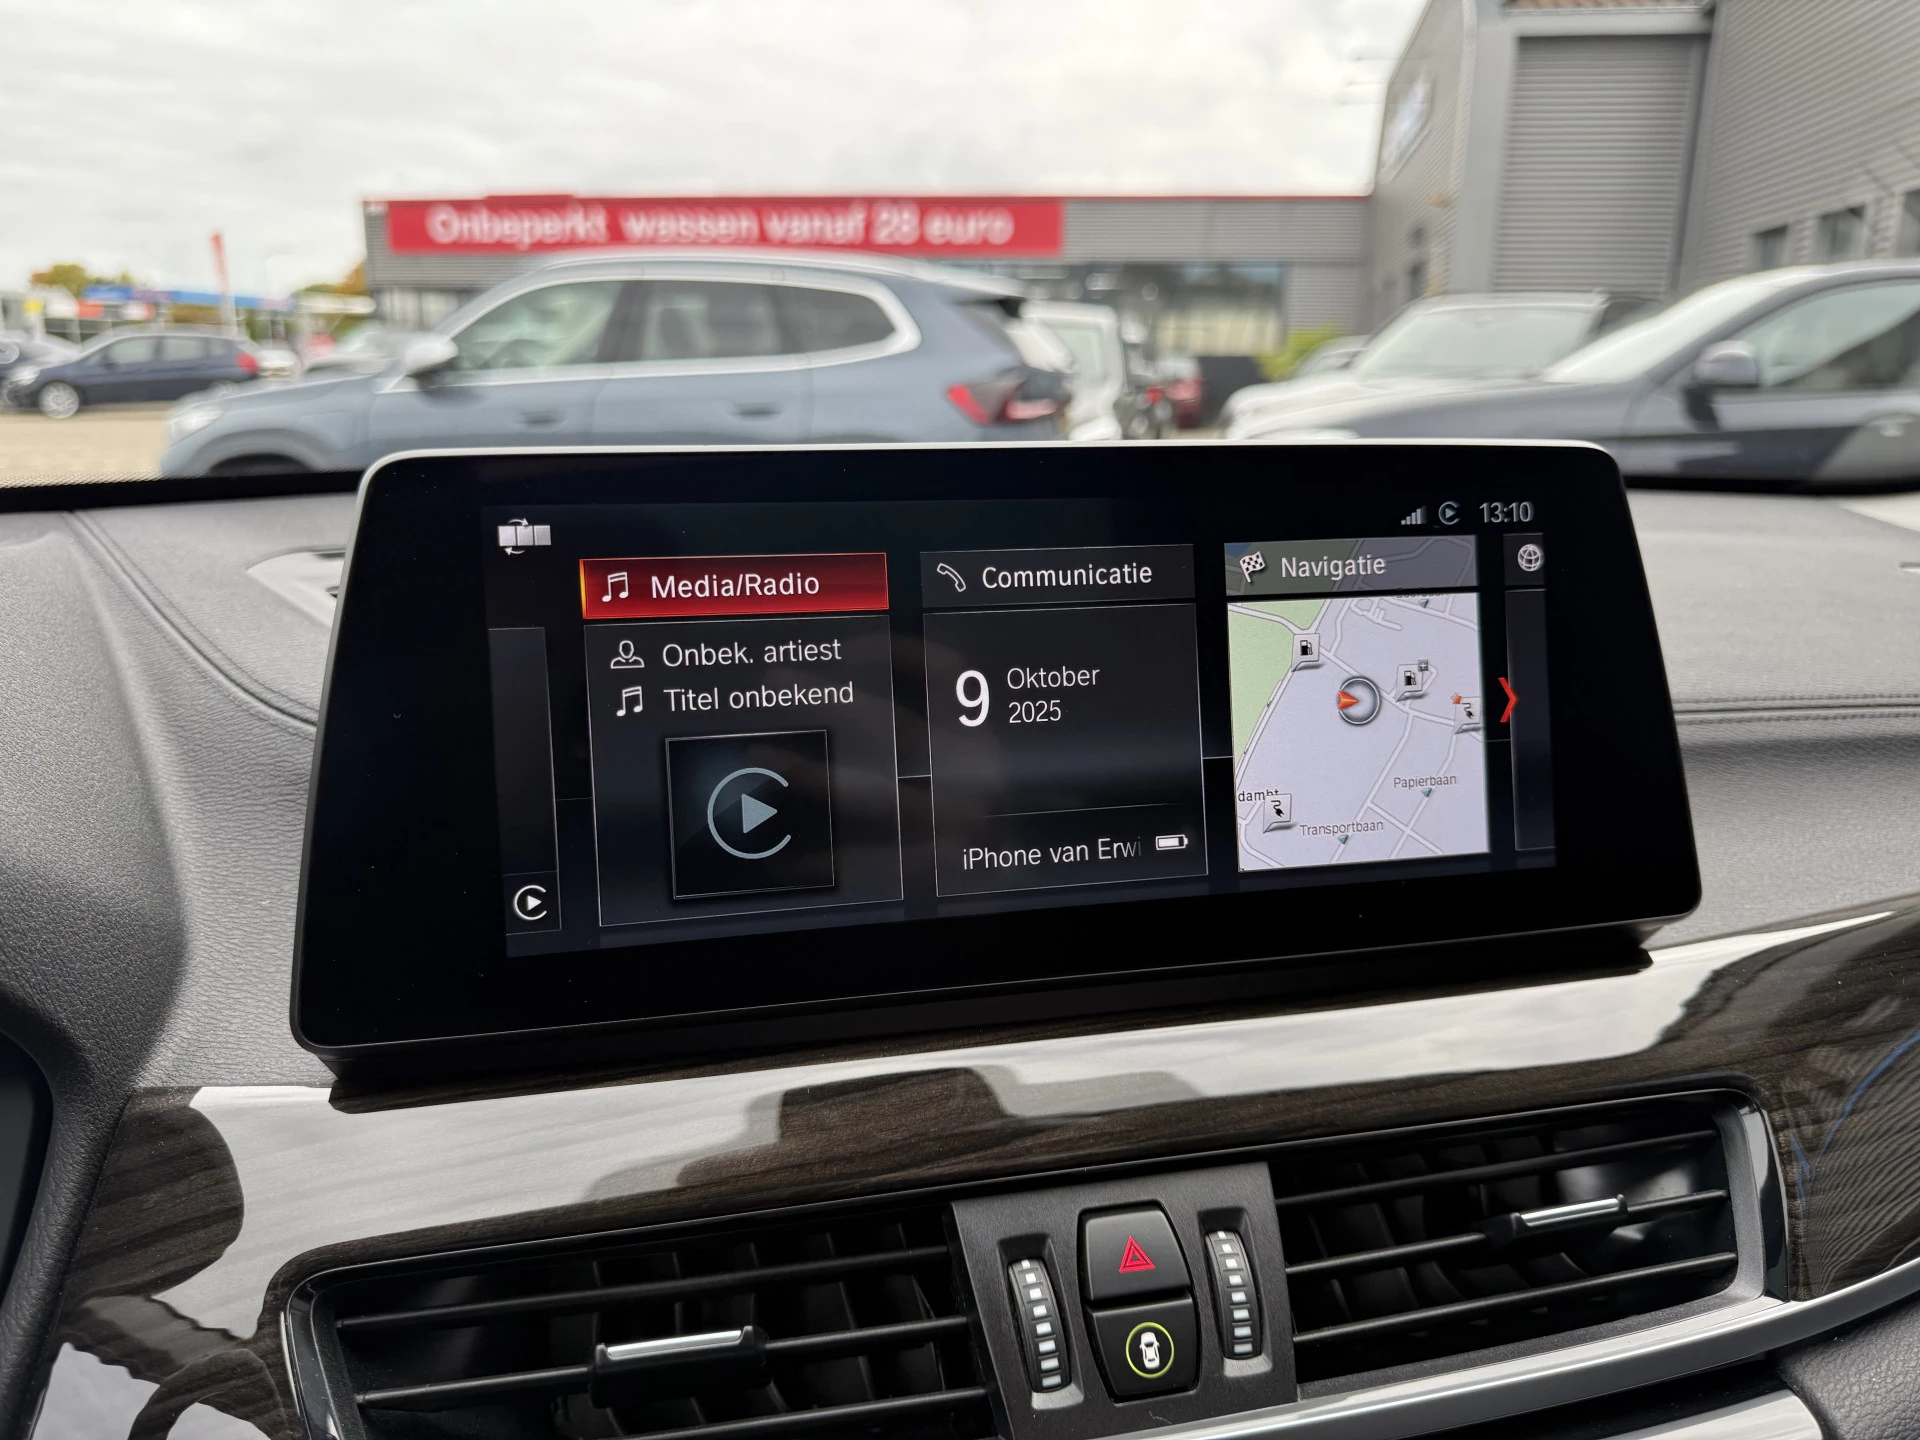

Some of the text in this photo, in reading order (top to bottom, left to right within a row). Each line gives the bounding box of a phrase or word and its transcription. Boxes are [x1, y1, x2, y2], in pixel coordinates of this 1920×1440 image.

[427, 203, 610, 250] Onbeperkt
[620, 208, 760, 245] wassen
[762, 200, 868, 245] vanaf
[924, 207, 1015, 246] euro
[1479, 501, 1534, 524] 13:10
[982, 562, 1153, 589] Communicatie
[1280, 554, 1387, 582] Navigatie
[650, 573, 820, 600] Media/Radio
[662, 638, 842, 667] Onbek. artiest
[1007, 667, 1100, 689] Oktober
[663, 681, 855, 712] Titel onbekend
[955, 670, 990, 727] 9
[1008, 700, 1062, 723] 2025
[1393, 773, 1457, 791] Papierbaan
[1299, 820, 1384, 839] Transportbaan
[962, 847, 1041, 870] iPhone
[1049, 843, 1089, 863] van
